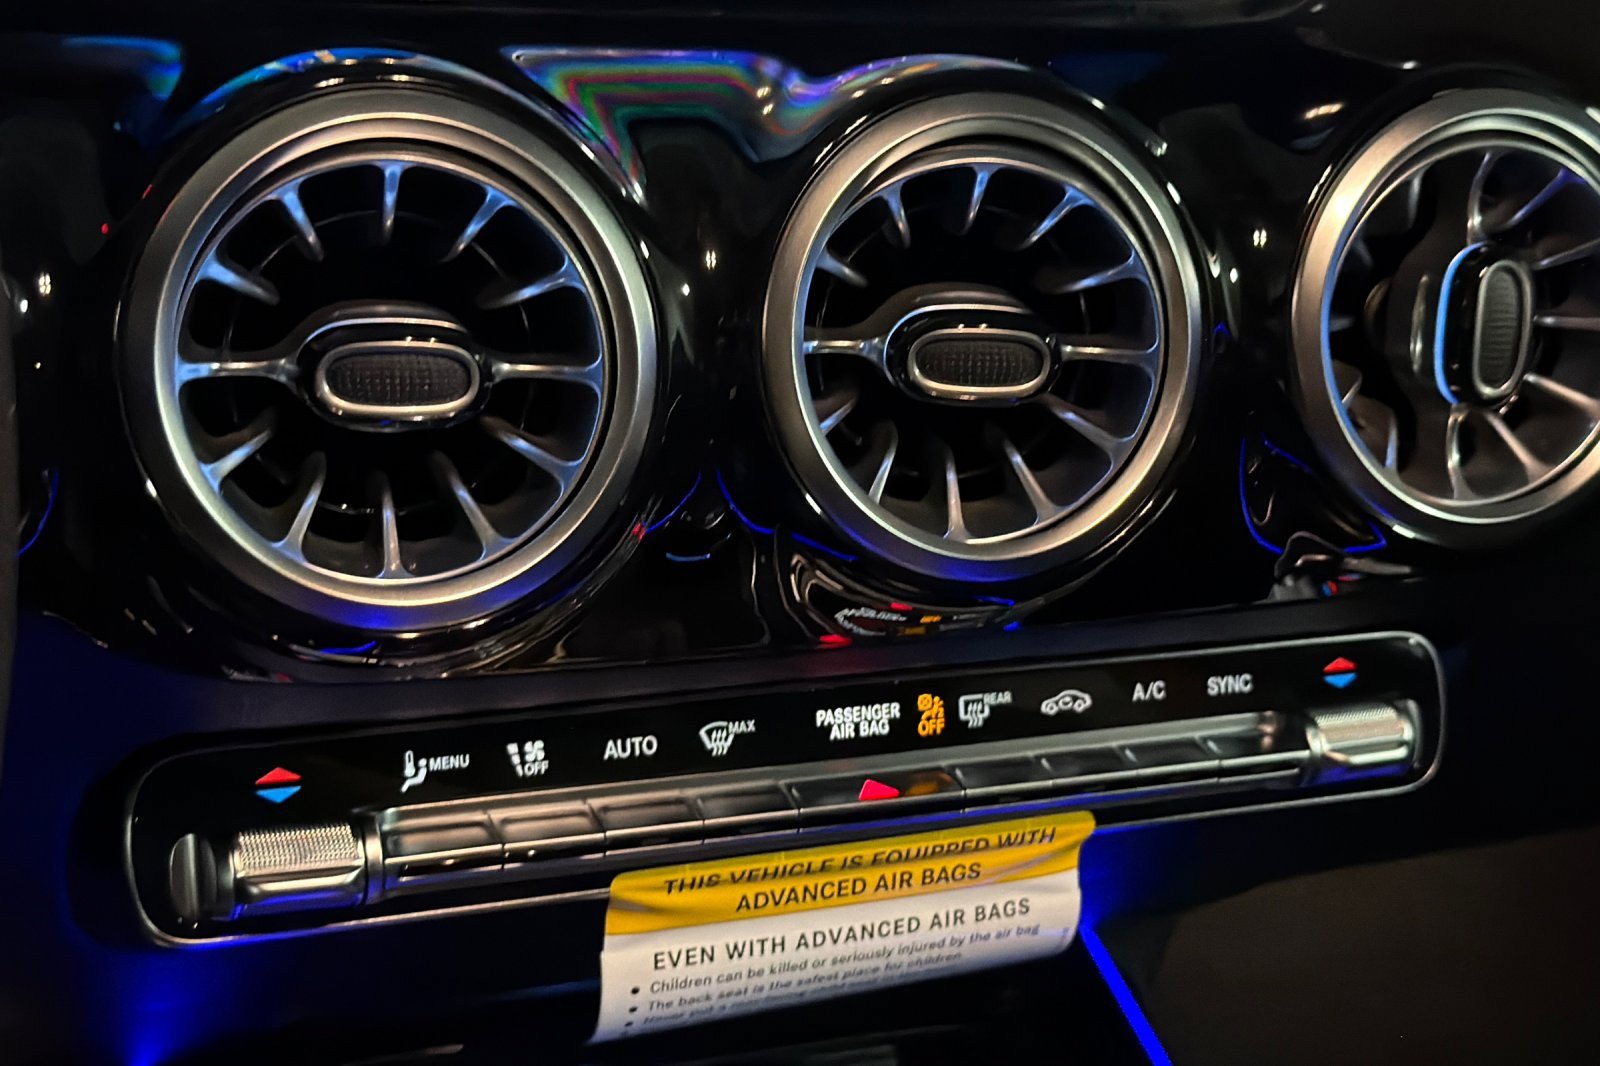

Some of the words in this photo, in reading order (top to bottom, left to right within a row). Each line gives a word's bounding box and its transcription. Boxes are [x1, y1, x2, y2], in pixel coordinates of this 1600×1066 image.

[1132, 680, 1166, 702] A/C
[1207, 673, 1253, 697] SYNC
[983, 690, 1012, 706] REAR
[815, 701, 901, 728] PASSENGER
[728, 719, 755, 735] MAX
[829, 721, 855, 741] AIR
[859, 719, 890, 738] BAG
[917, 719, 945, 737] OFF
[603, 735, 658, 760] AUTO
[429, 753, 470, 772] MENU
[524, 760, 549, 777] OFF
[664, 873, 721, 895] THIS
[729, 857, 836, 885] VEHICLE
[840, 854, 864, 870] IS
[998, 826, 1057, 848] WITH
[736, 878, 867, 913] ADVANCED
[874, 870, 913, 893] AIR
[921, 862, 982, 886] BAGS
[653, 945, 715, 971] EVEN
[725, 935, 786, 961] WITH
[796, 916, 921, 951] ADVANCED
[929, 909, 966, 930] AIR
[974, 898, 1031, 923] BAGS
[650, 975, 712, 995] Children
[716, 971, 743, 984] can
[747, 964, 765, 979] be
[769, 955, 808, 976] killed
[811, 958, 826, 970] or
[830, 942, 893, 966] seriously
[897, 934, 946, 955] injured
[949, 933, 966, 948] by
[969, 928, 991, 944] the
[995, 925, 1011, 940] air
[648, 1000, 674, 1012] The
[678, 991, 713, 1006] back
[717, 986, 748, 1001] seat
